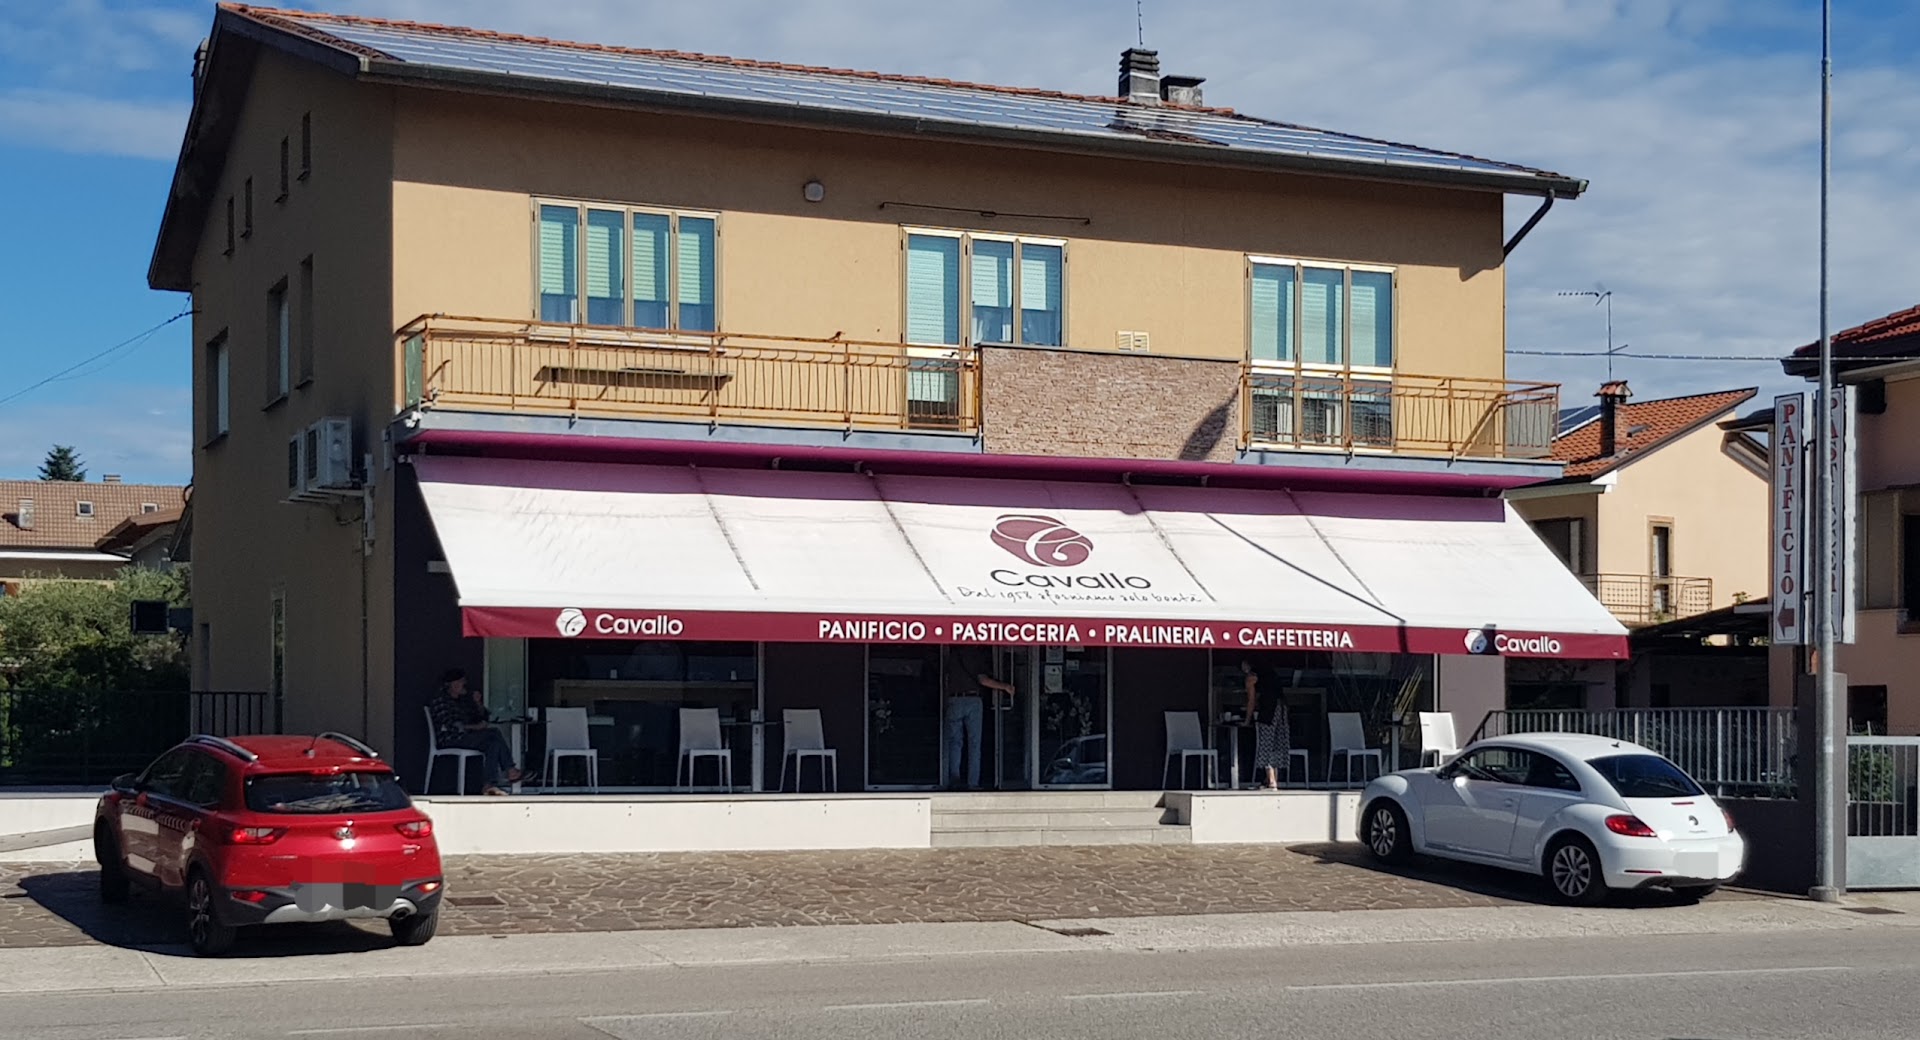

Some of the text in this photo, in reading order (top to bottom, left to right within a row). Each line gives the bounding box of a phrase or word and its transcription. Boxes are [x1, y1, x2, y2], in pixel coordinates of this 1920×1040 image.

[1780, 403, 1796, 595] PANIFICIO
[990, 569, 1151, 589] Cavallo
[957, 586, 996, 598] Dal
[595, 613, 684, 636] Cavallo
[818, 620, 1354, 648] PANIFICIO PASTICCERIA PRALINERIA CAFFETTERIA
[1494, 634, 1561, 653] Cavallo
